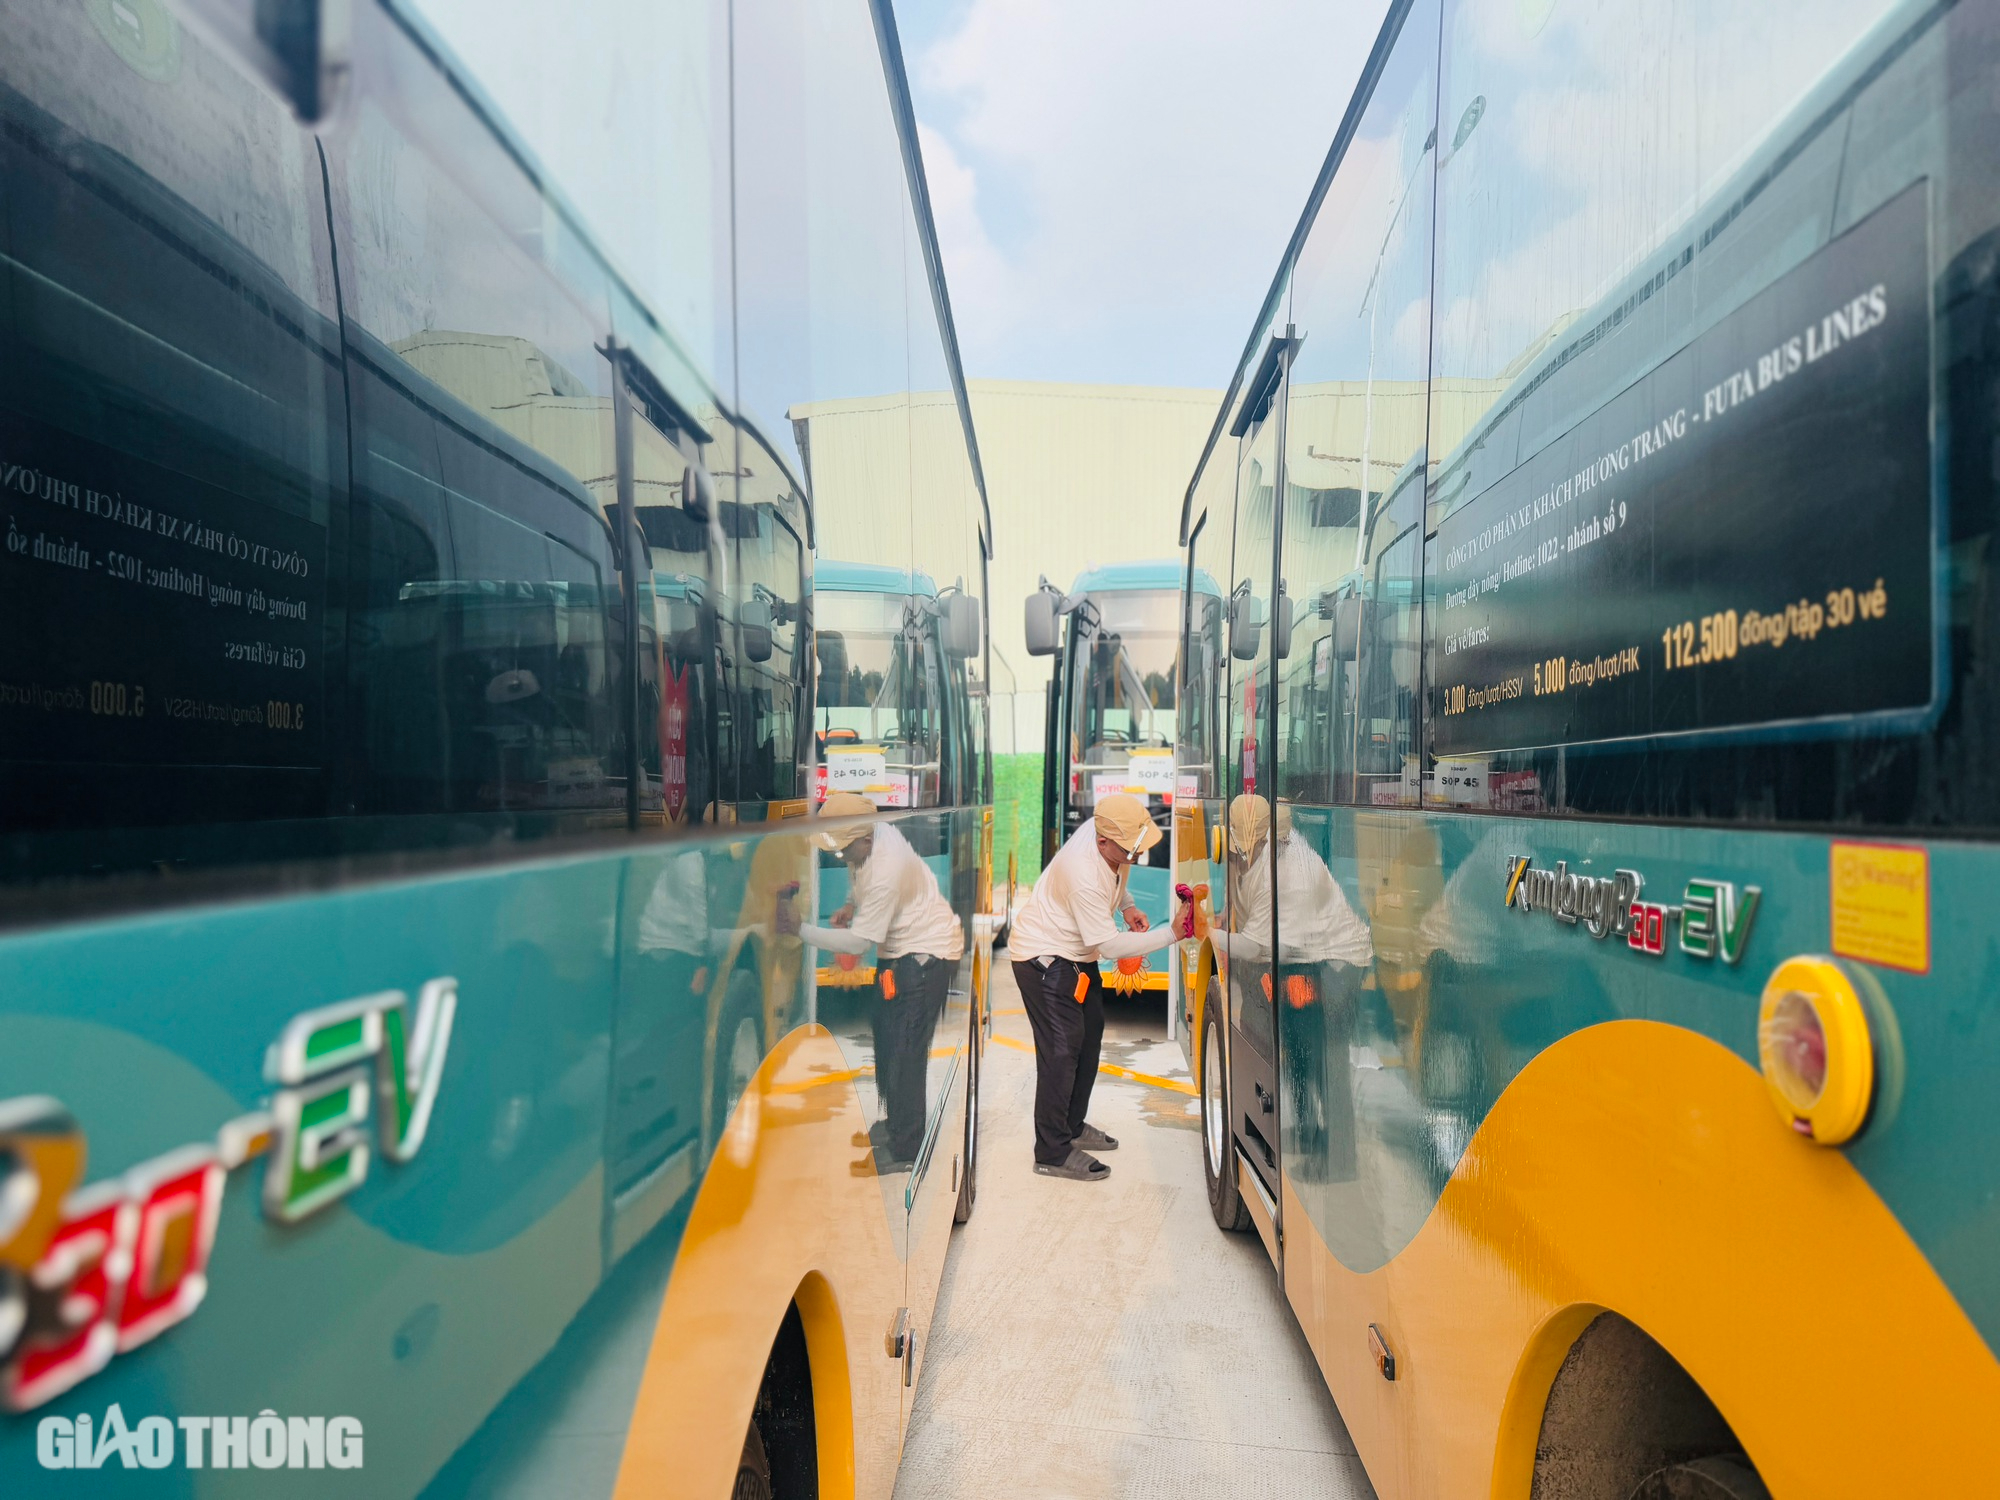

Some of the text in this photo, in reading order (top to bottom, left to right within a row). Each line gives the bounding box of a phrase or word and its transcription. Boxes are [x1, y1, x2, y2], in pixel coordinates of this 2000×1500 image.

[1446, 545, 1466, 571] CÔNG
[1468, 536, 1479, 559] TY
[1479, 523, 1491, 552] CỔ
[1518, 504, 1531, 530] XE
[1533, 479, 1572, 521] KHÁCH
[1574, 444, 1629, 498] PHƯƠNG
[1632, 409, 1686, 463] TRANG
[1704, 368, 1754, 422] FUTA
[1757, 336, 1802, 391] BUS
[1806, 283, 1887, 363] LINES
[1446, 587, 1467, 610] Đường
[1468, 578, 1480, 602] dây
[1503, 553, 1536, 583] Hotline:
[1538, 536, 1558, 566] 1022
[1567, 515, 1600, 553] nhánh
[1603, 498, 1616, 535] số
[1619, 501, 1627, 528] 9
[1444, 629, 1457, 656] Giá
[1444, 684, 1466, 716] 3.000
[1534, 656, 1566, 696] 5.000
[1569, 646, 1640, 687] đồng/lượt/HK
[1662, 608, 1738, 670] 112.500
[1826, 587, 1855, 628] 30
